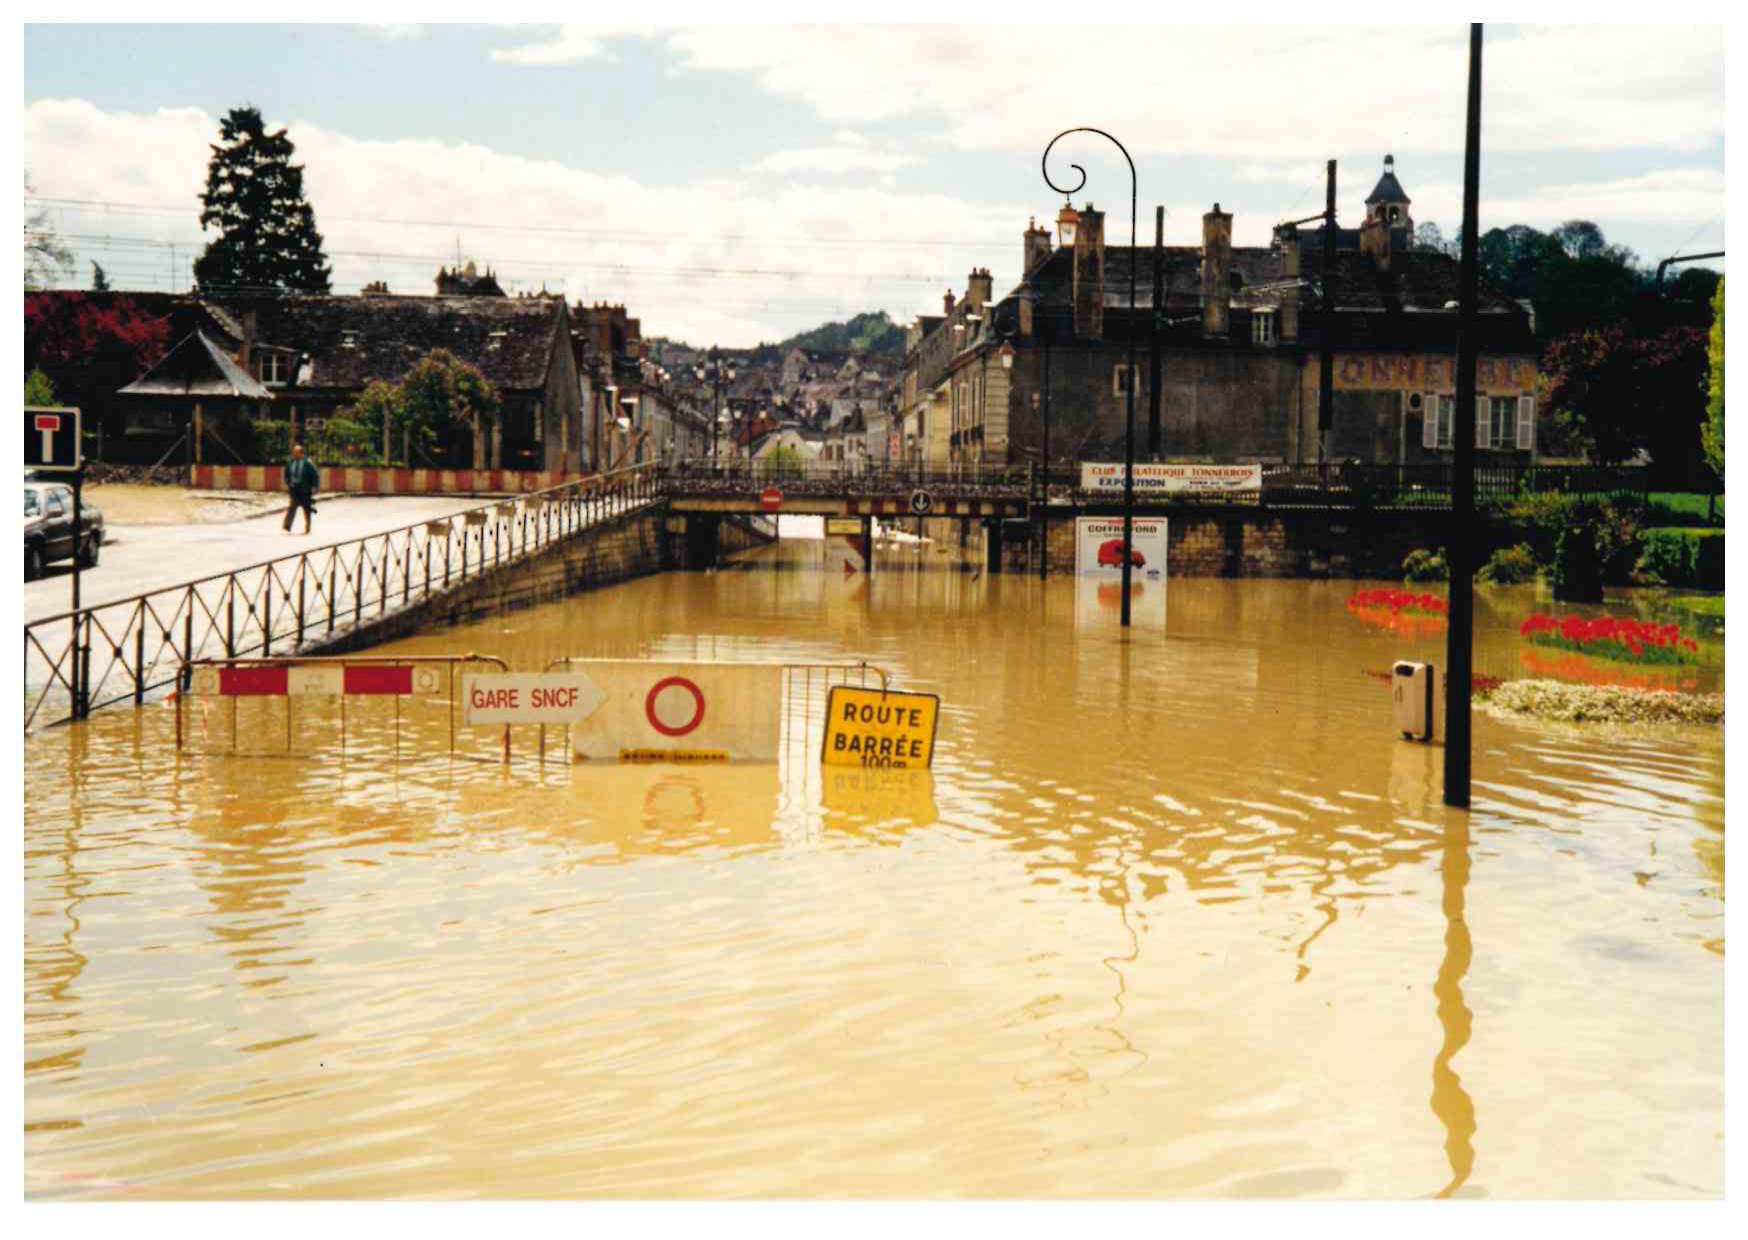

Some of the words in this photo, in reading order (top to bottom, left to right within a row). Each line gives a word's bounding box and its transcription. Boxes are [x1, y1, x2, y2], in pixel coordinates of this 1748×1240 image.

[471, 688, 520, 709] GARE
[531, 687, 579, 708] SNCF
[843, 702, 922, 728] ROUTE
[833, 732, 924, 758] BARRÉE
